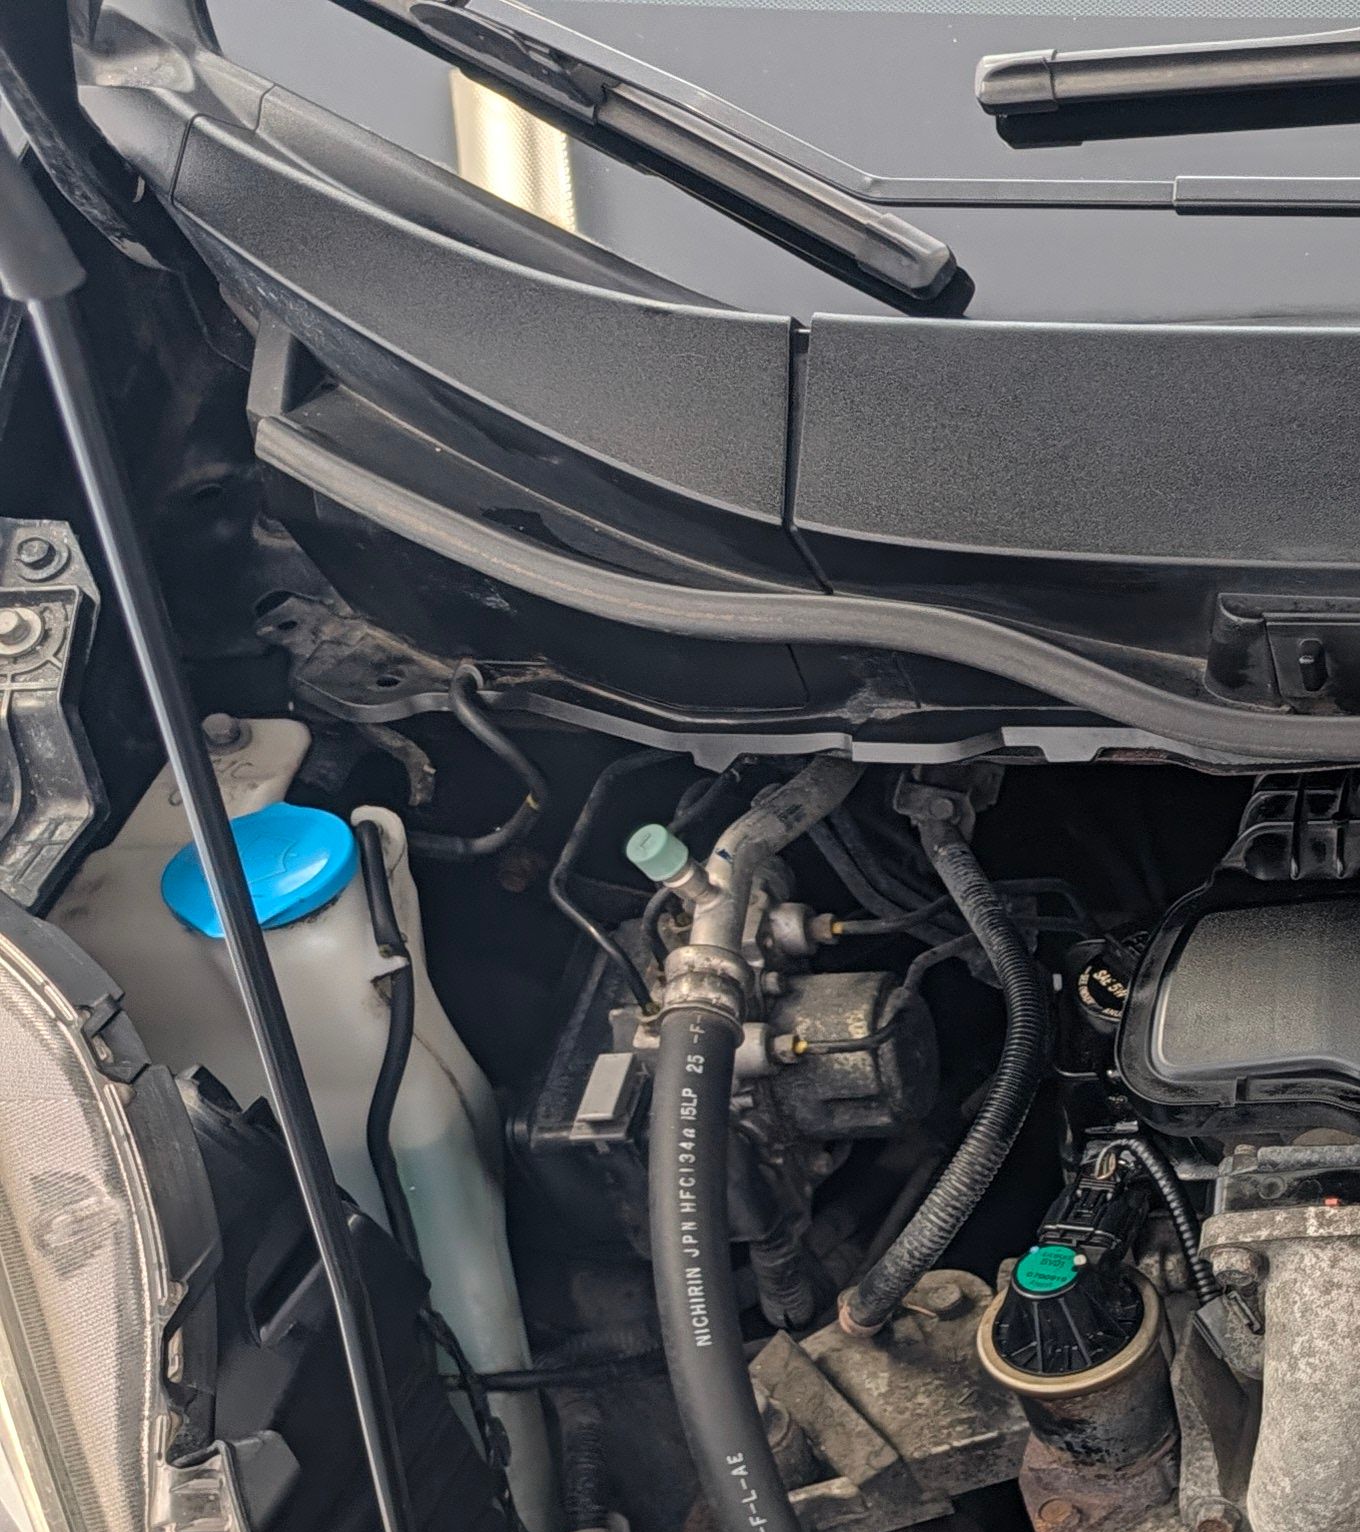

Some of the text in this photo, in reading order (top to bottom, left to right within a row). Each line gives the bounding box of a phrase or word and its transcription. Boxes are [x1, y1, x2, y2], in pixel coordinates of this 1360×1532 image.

[685, 1053, 705, 1076] 25
[680, 1221, 701, 1259] JPN
[684, 1267, 713, 1348] NICHIRIN
